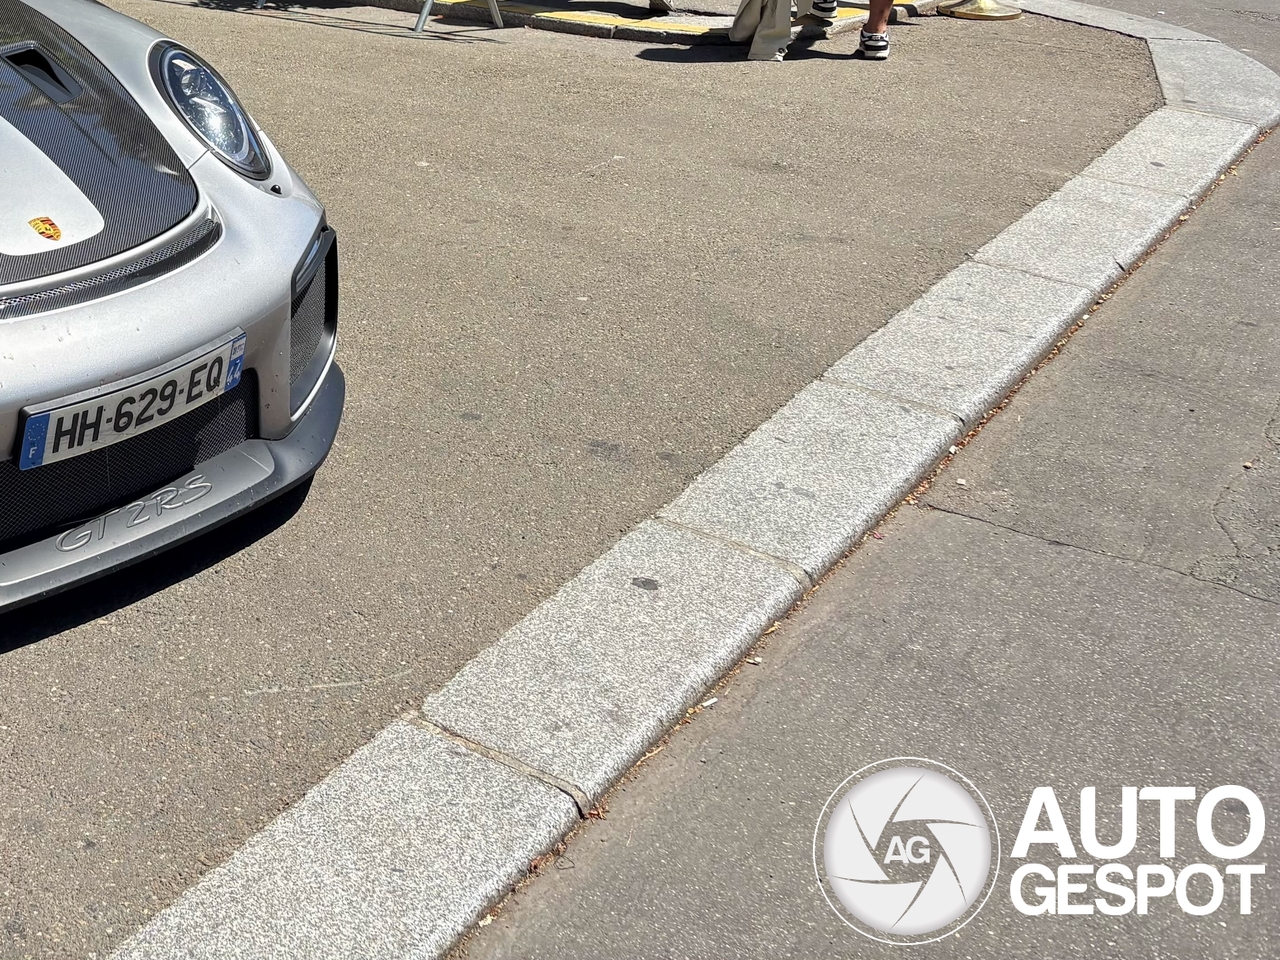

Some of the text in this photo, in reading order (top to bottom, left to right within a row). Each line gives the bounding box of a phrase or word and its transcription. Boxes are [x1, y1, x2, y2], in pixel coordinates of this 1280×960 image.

[28, 355, 242, 459] F HH-629-EQ 44
